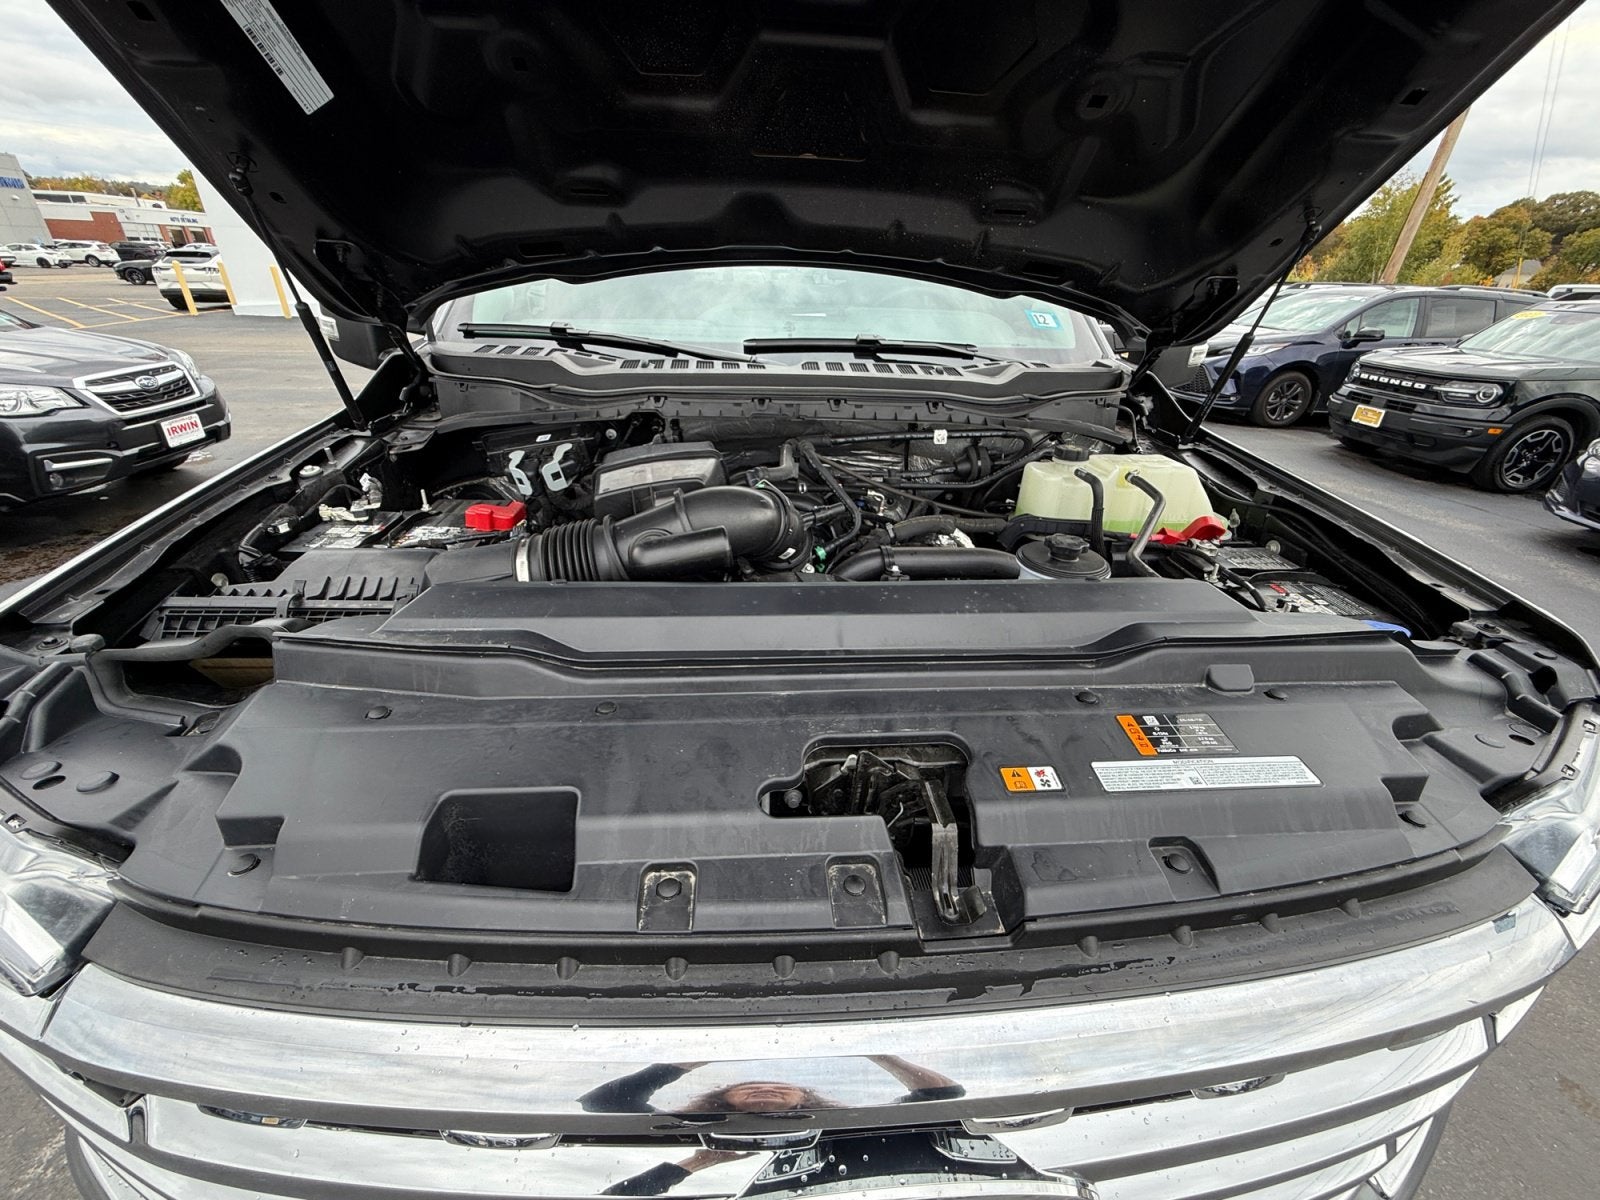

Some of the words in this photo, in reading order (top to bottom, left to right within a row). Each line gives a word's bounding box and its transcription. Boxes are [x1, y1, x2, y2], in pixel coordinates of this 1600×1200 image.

[1033, 314, 1050, 325] 12
[1360, 373, 1426, 389] BRONCO
[167, 420, 199, 437] IRWIN
